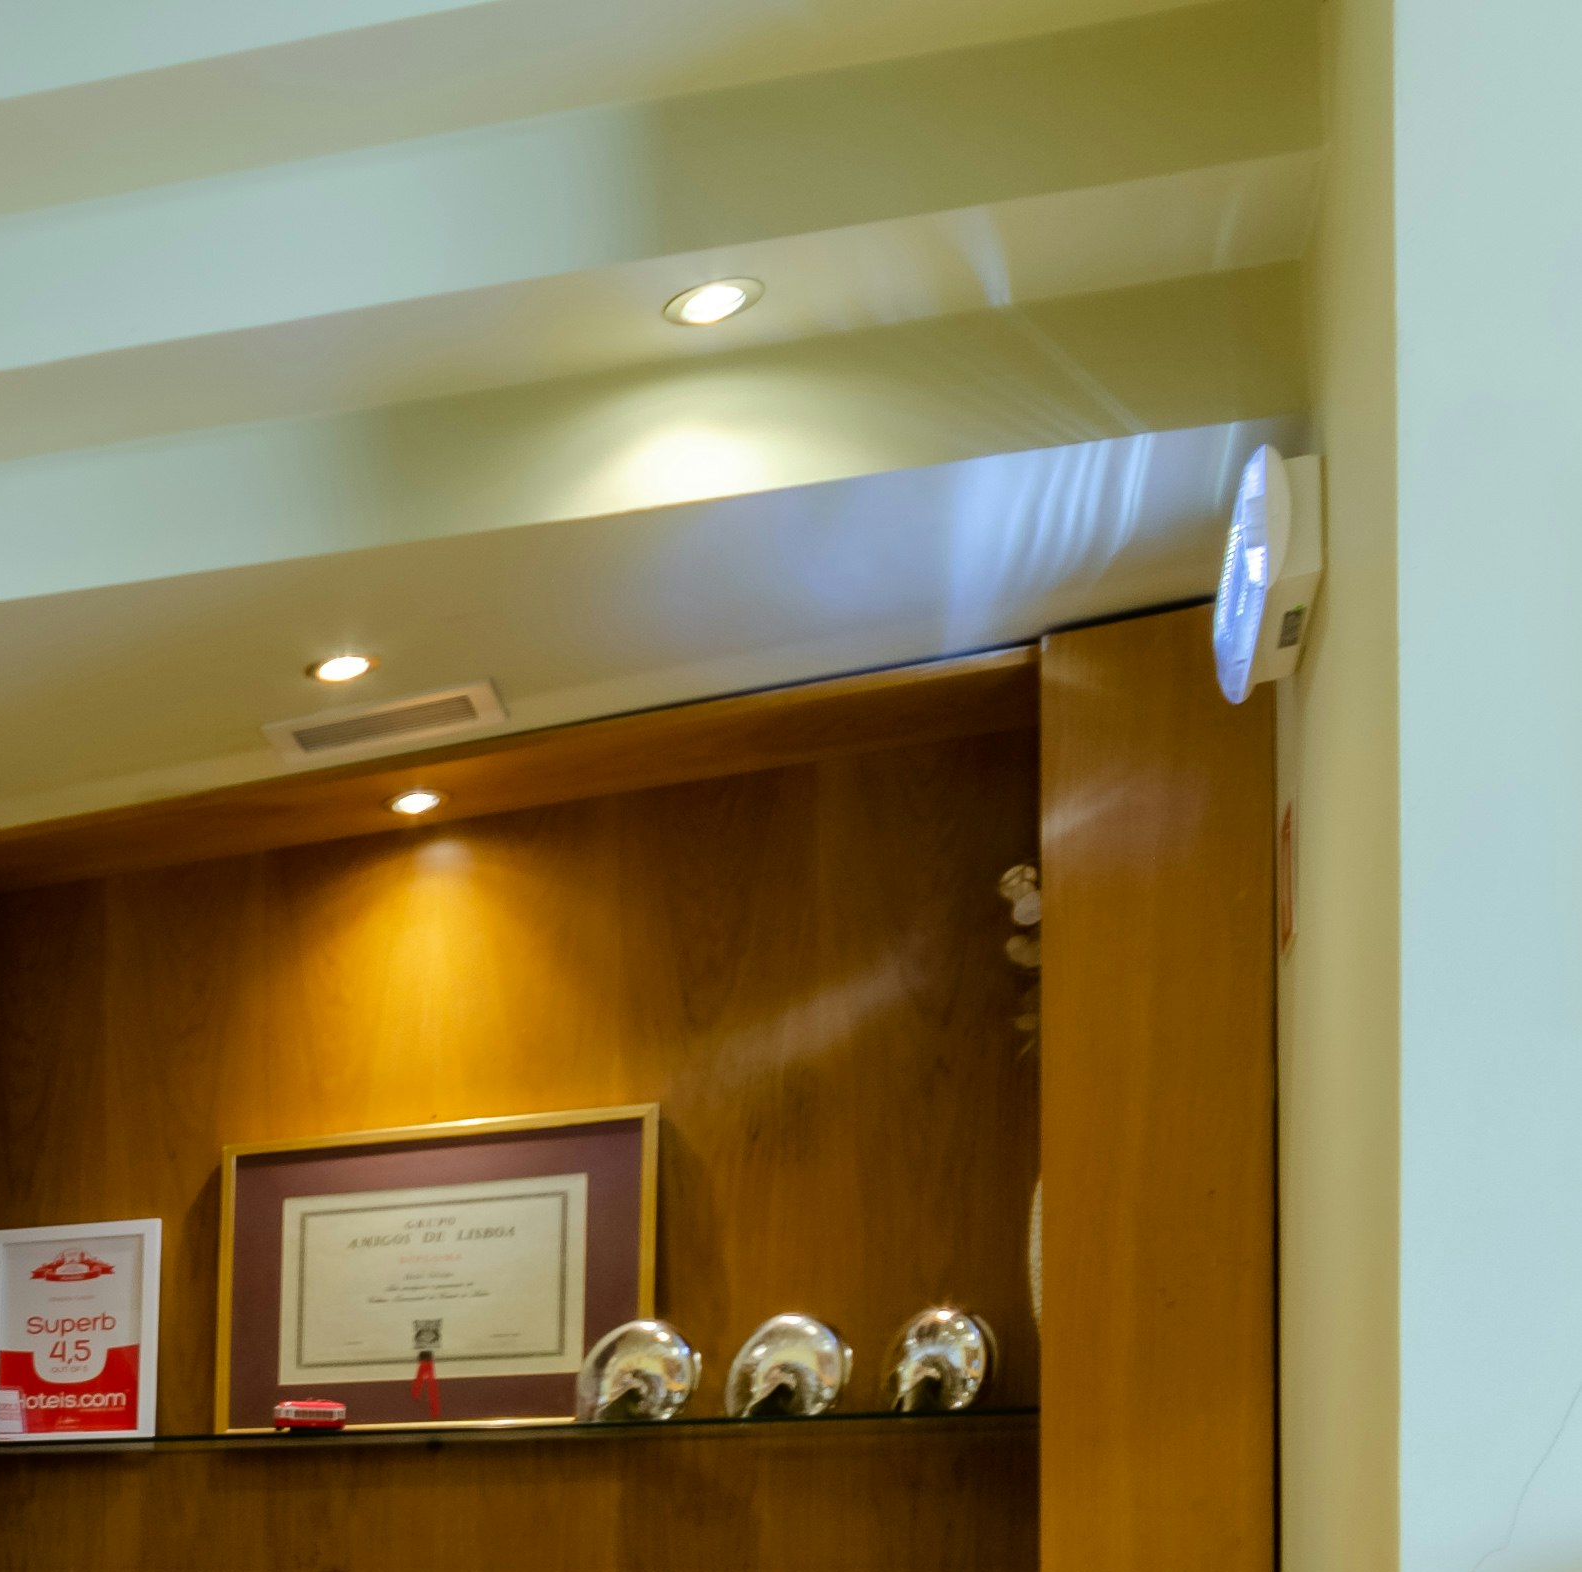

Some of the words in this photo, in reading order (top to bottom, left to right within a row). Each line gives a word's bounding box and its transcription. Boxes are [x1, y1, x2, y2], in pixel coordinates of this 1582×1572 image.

[348, 1233, 412, 1249] AMIGOS
[422, 1231, 444, 1243] DE
[456, 1226, 516, 1241] LISBOA
[26, 1312, 116, 1336] Superb
[49, 1340, 92, 1364] 4,5
[51, 1366, 66, 1374] OUT
